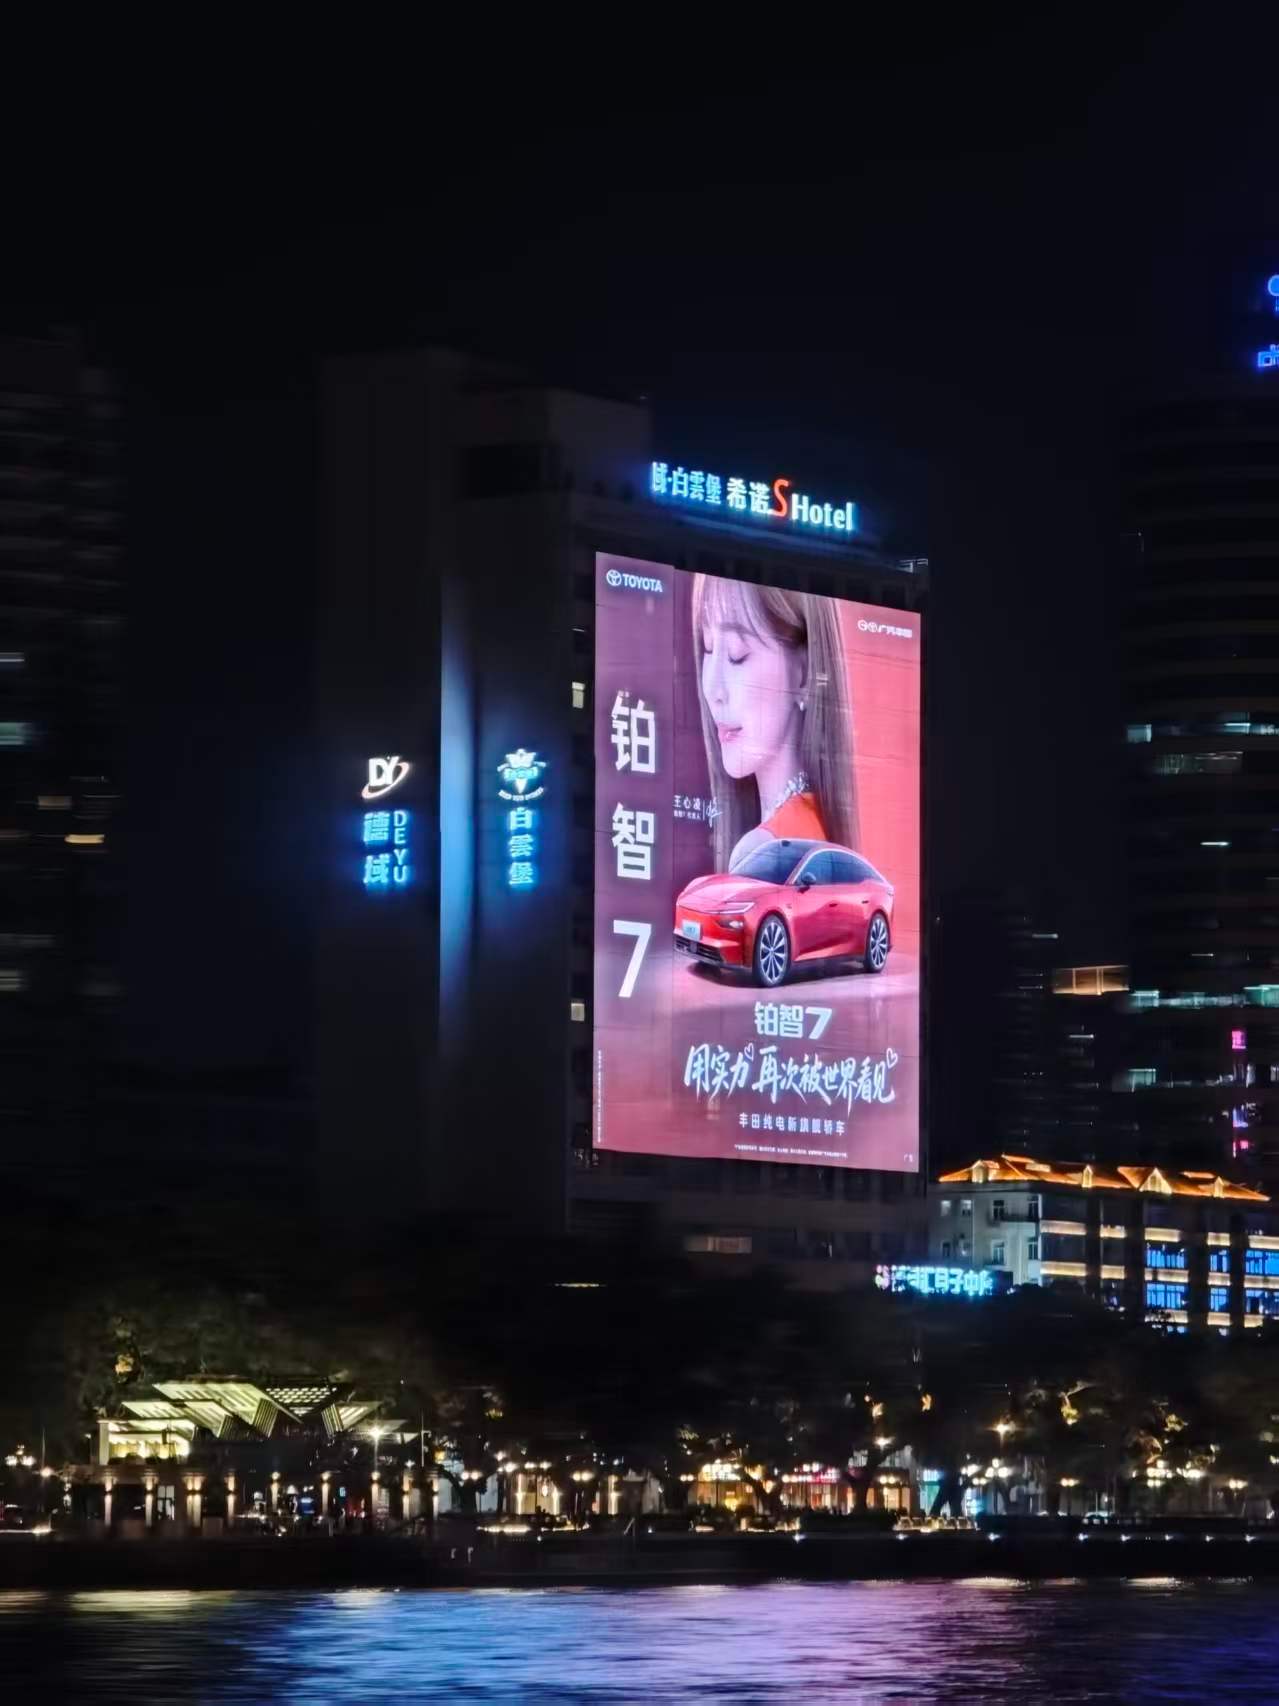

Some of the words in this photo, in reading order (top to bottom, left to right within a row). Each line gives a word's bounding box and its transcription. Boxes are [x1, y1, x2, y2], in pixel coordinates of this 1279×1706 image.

[726, 477, 771, 514] 希诺
[791, 493, 853, 530] Hotel
[622, 573, 663, 594] TOYOTA
[753, 1001, 833, 1040] 铂智7
[739, 1112, 846, 1136] 丰田纯电新旗舰轿车
